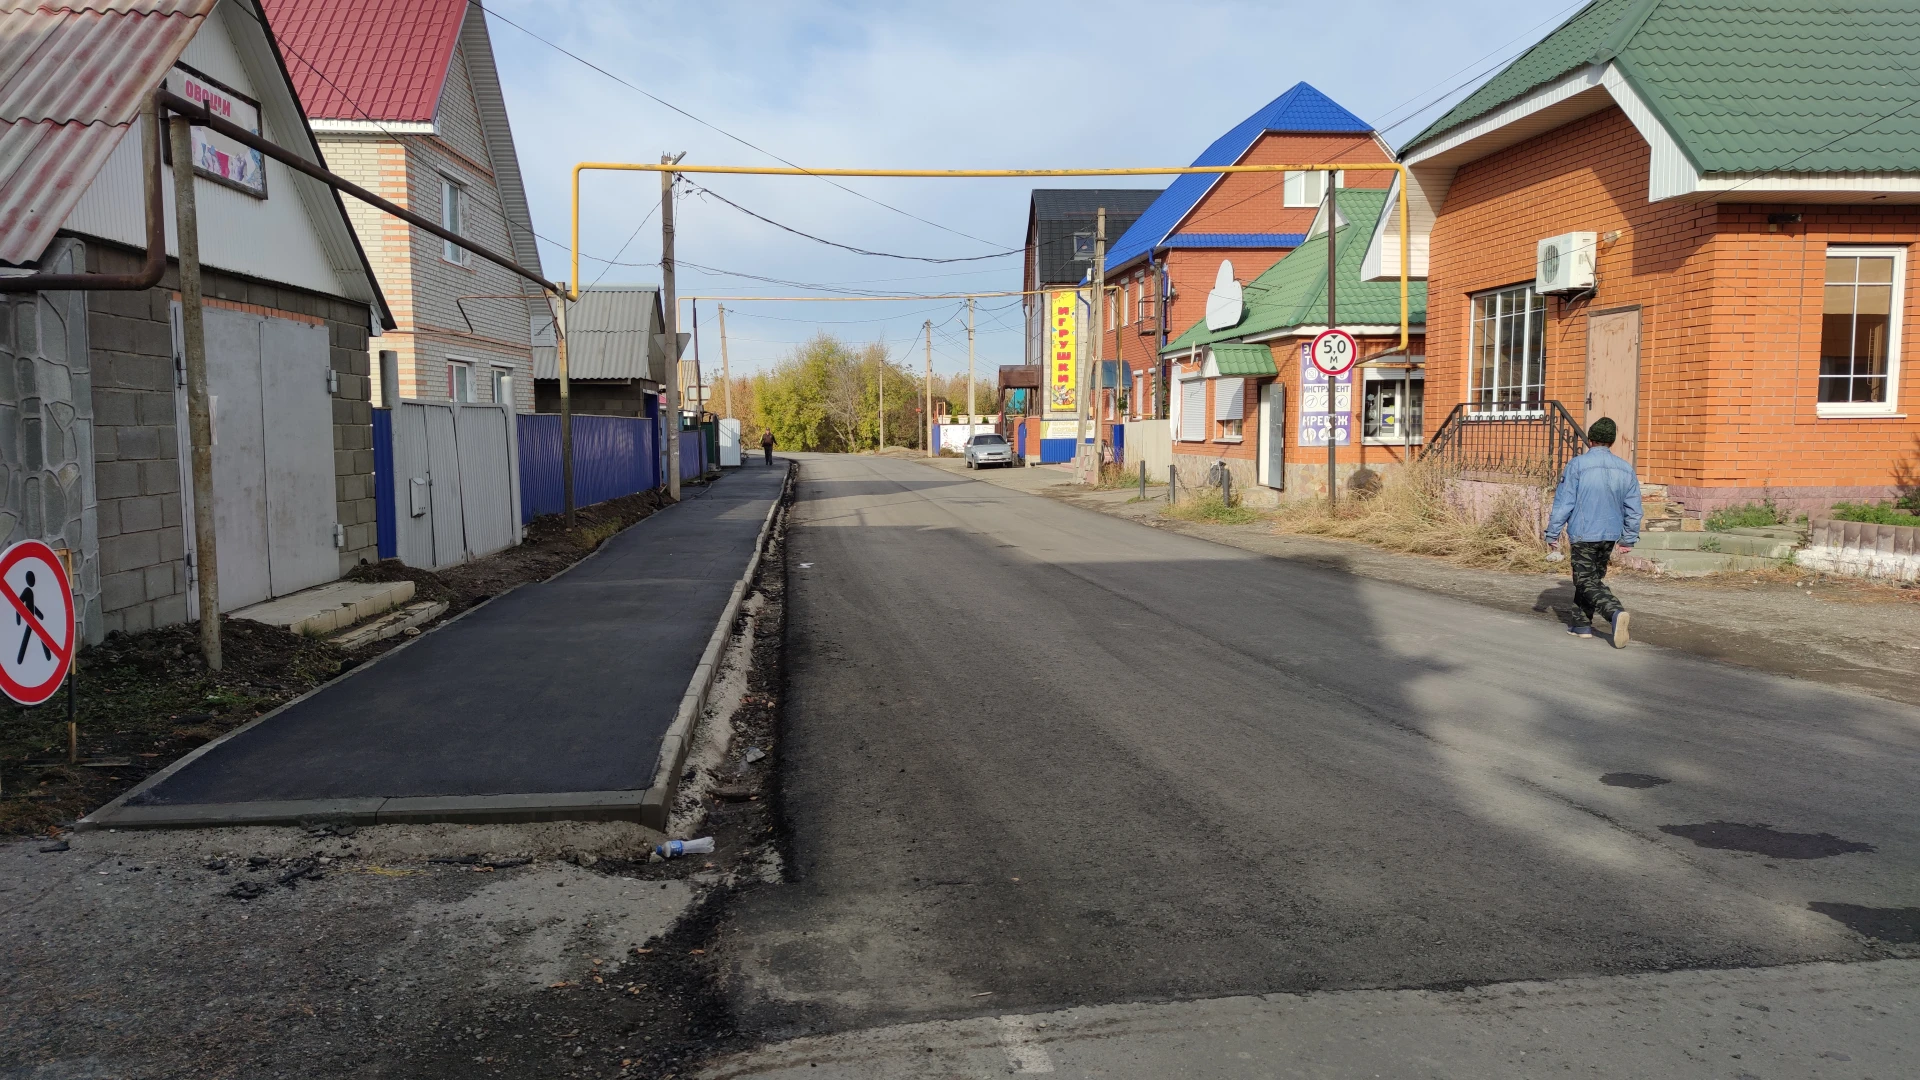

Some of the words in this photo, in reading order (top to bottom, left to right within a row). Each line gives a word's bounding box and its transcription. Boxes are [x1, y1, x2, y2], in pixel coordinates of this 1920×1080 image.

[185, 80, 231, 117] ОВОЩИ
[1056, 306, 1072, 383] ИГРУШКИ
[1323, 340, 1346, 355] 5,0
[1303, 385, 1350, 393] ИНСТРУЕНТ
